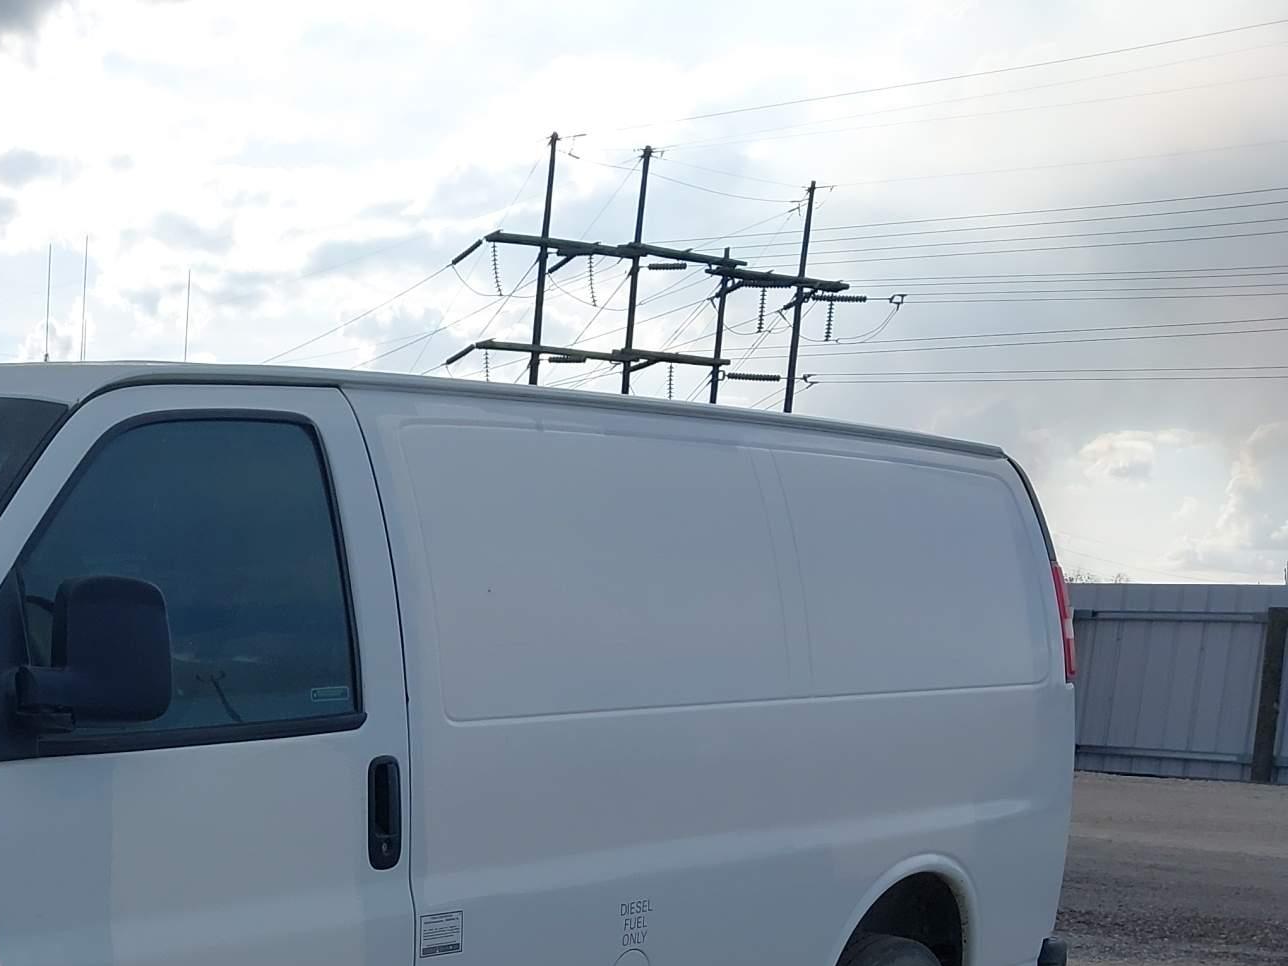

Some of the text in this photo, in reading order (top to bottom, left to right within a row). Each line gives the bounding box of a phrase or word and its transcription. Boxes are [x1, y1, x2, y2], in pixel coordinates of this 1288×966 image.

[620, 899, 653, 916] DIESEL
[623, 916, 648, 931] FUEL
[622, 931, 648, 946] ONLY
